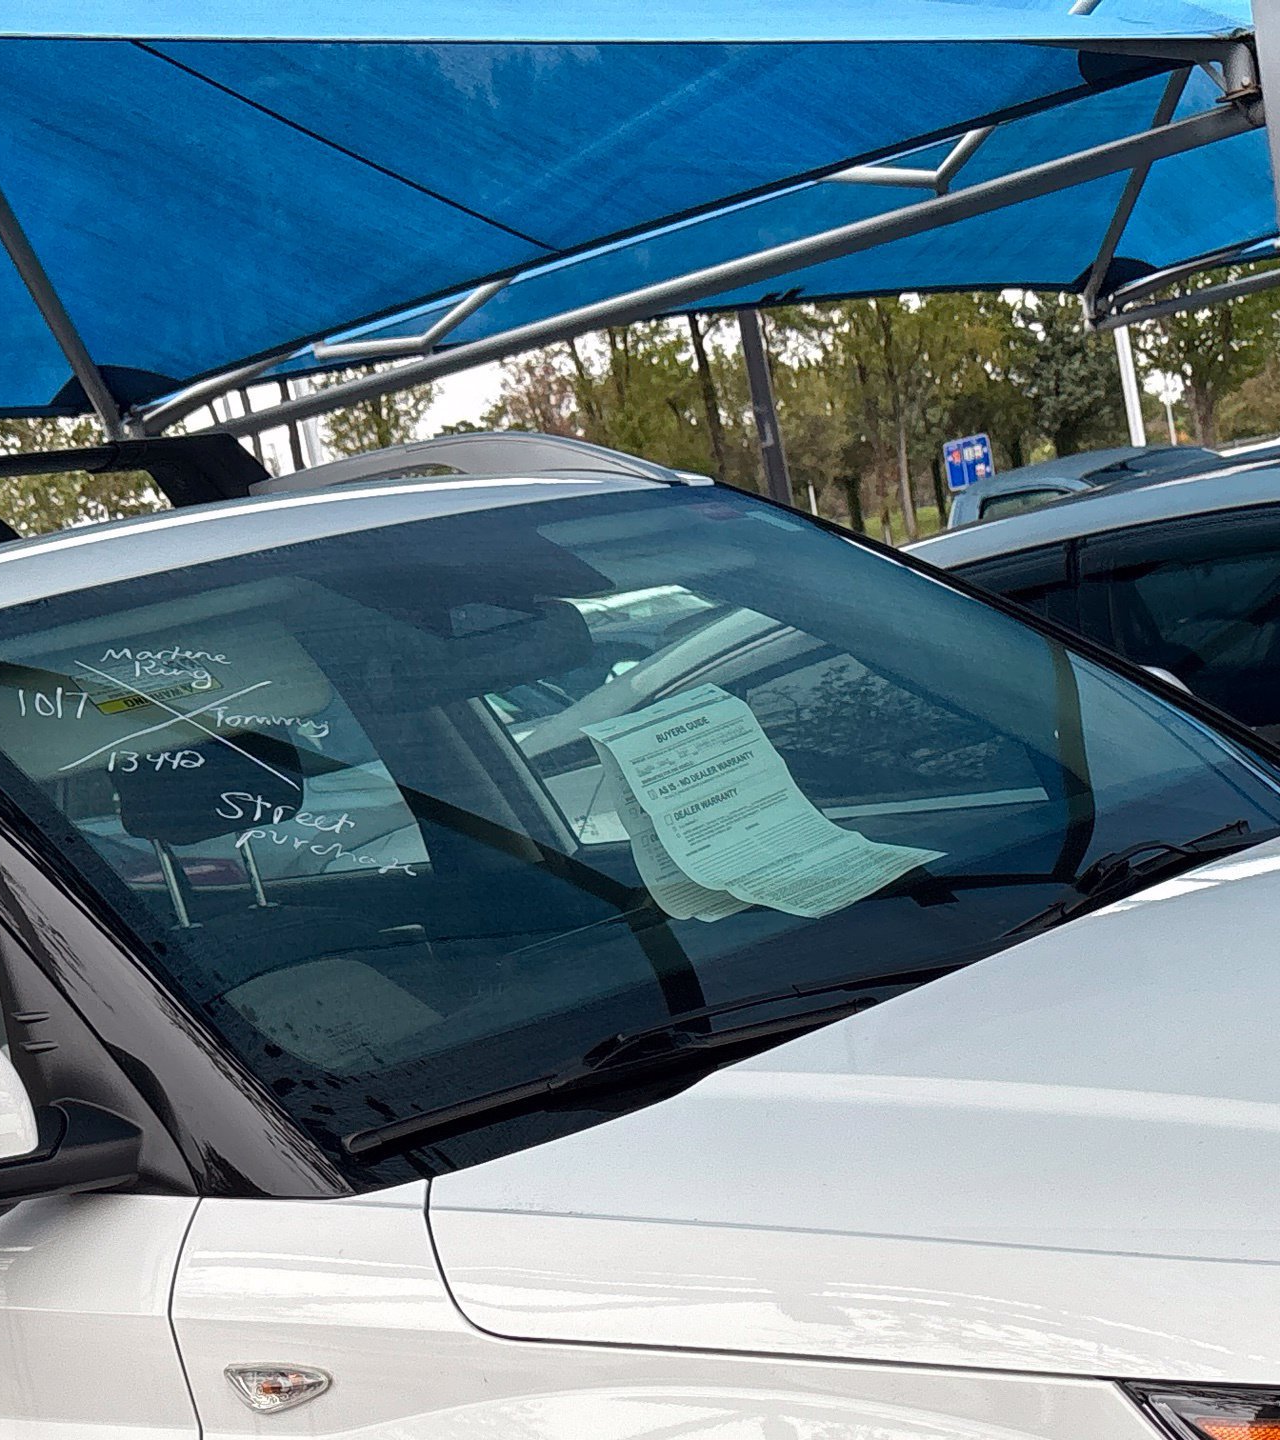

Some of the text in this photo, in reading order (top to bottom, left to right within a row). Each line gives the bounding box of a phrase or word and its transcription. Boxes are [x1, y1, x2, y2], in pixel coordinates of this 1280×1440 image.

[656, 716, 710, 743] BUYERS GUIDE
[658, 785, 669, 796] AS
[680, 775, 691, 787] NO
[691, 765, 718, 784] DEALER
[718, 750, 755, 772] WARRANTY
[216, 791, 355, 834] Street
[674, 802, 701, 821] DEALER
[700, 788, 739, 811] WARRANTY
